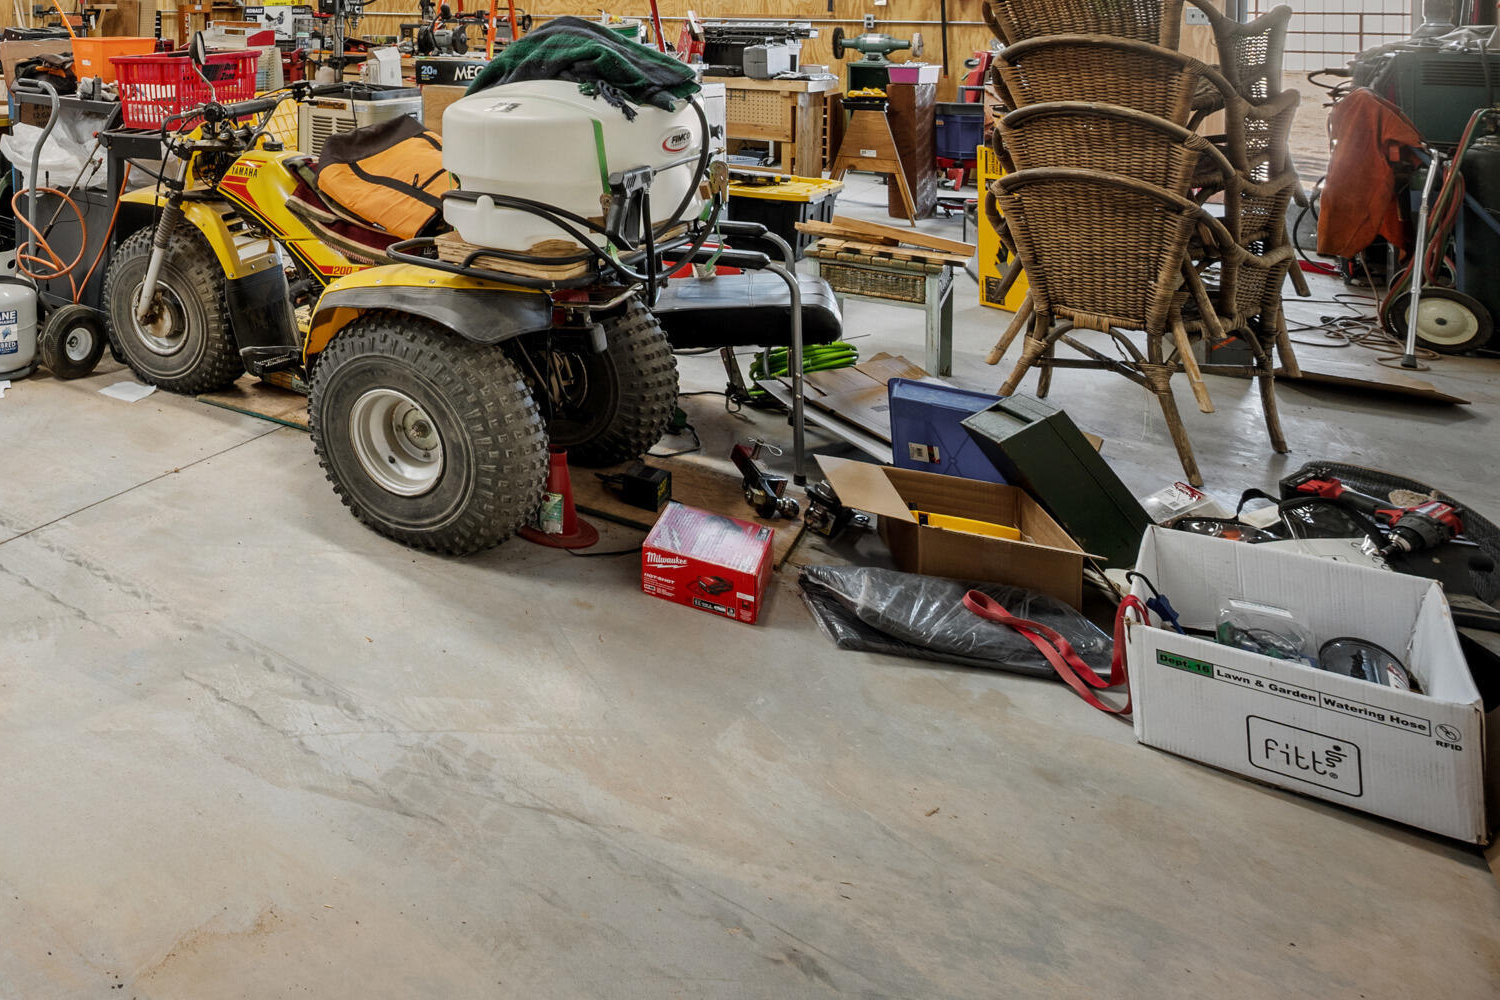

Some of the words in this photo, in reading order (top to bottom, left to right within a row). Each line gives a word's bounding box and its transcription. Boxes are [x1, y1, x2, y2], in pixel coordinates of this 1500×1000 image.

[231, 166, 258, 178] YAMAHA
[333, 266, 352, 275] 200
[645, 551, 688, 565] Milwaukee
[1160, 654, 1191, 669] Dept.
[1196, 664, 1210, 673] 16
[1216, 669, 1250, 684] Lawn
[1255, 680, 1264, 688] &
[1268, 683, 1317, 702] Garden
[1323, 697, 1385, 722] Watering
[1390, 715, 1427, 731] Hose
[1435, 740, 1462, 752] RFID
[1265, 738, 1327, 775] fitt
